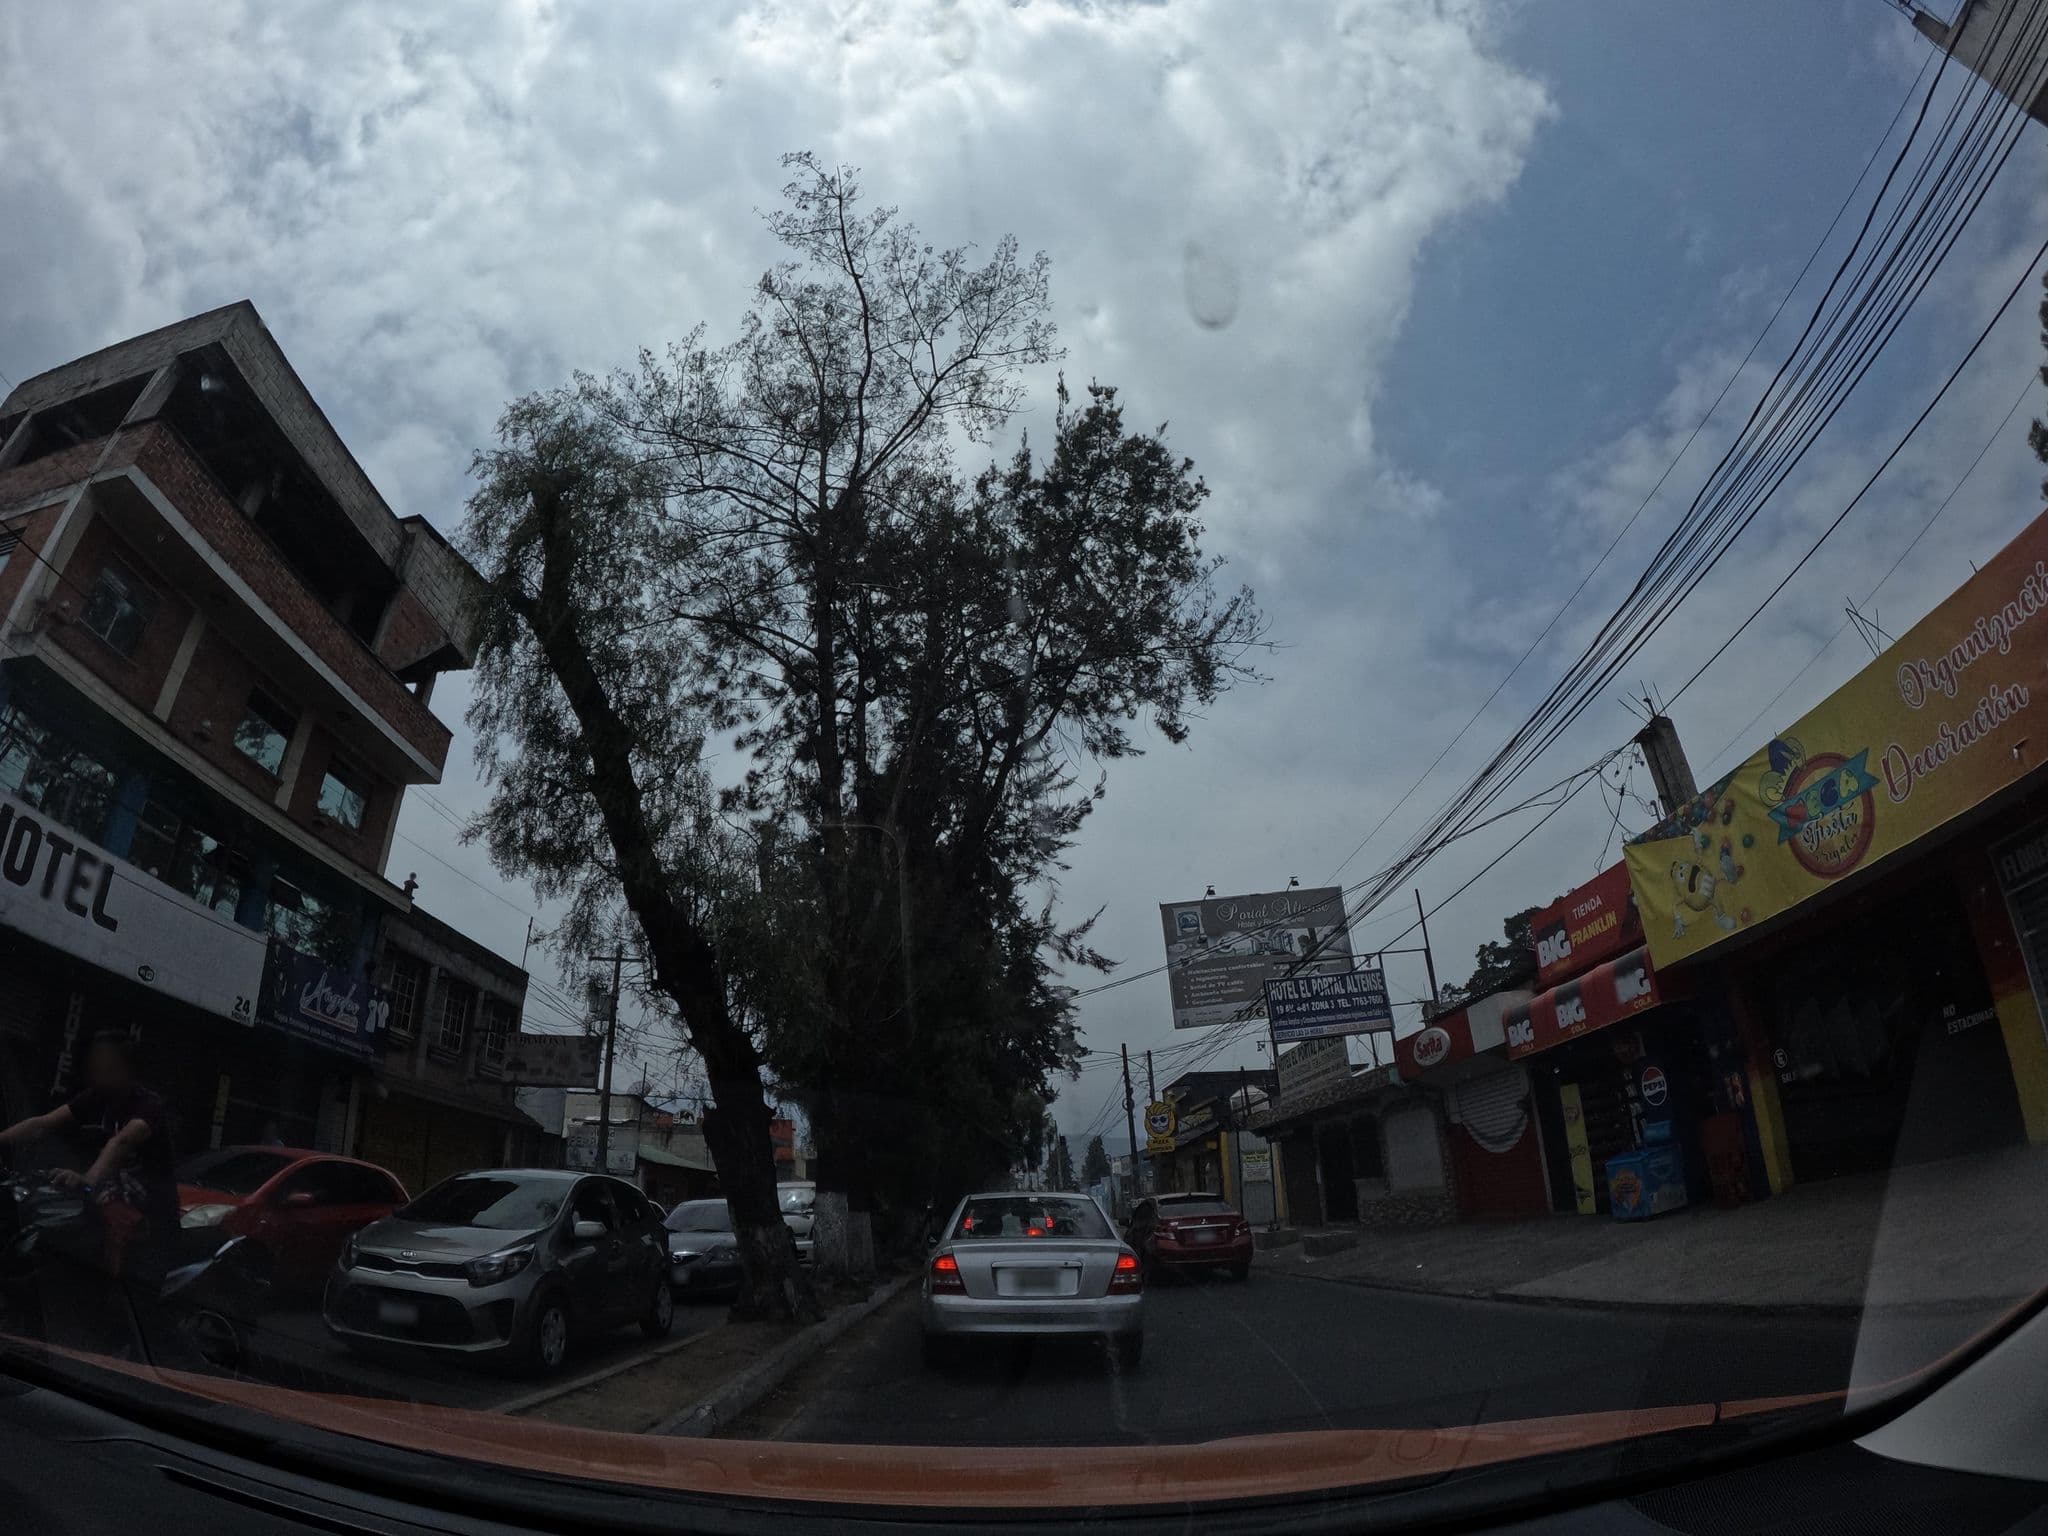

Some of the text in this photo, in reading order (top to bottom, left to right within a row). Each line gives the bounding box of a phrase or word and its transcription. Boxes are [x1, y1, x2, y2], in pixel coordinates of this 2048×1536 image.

[1880, 683, 2030, 804] Decoración
[1572, 895, 1602, 920] TIENDA
[1571, 911, 1617, 946] FRANKLIN
[1537, 929, 1572, 968] BIG
[1269, 971, 1385, 1002] HOTEL EL PORTAL ALTENSE
[236, 995, 250, 1015] 24
[1311, 1000, 1330, 1011] ZONA
[1555, 997, 1586, 1029] BIG
[1943, 1003, 1956, 1018] NO
[1508, 1019, 1535, 1048] BIG
